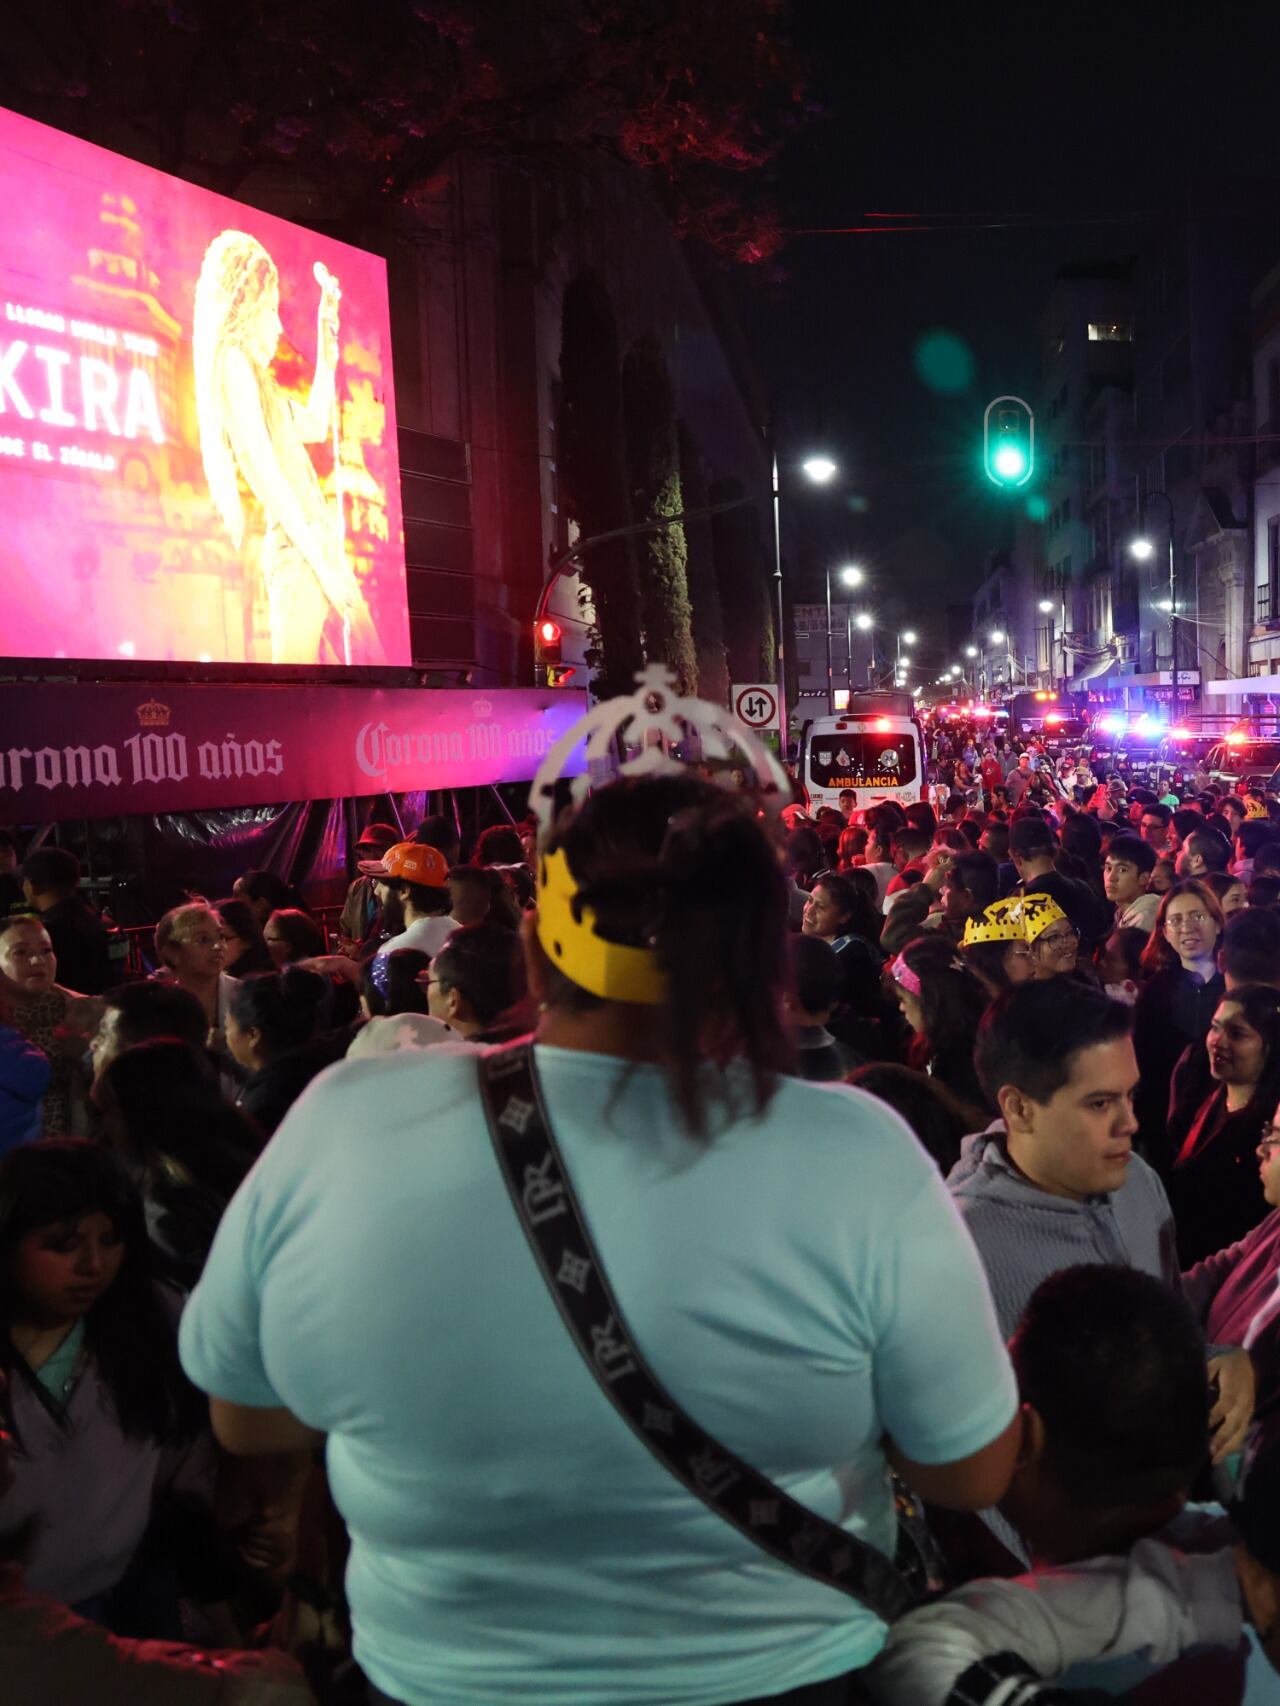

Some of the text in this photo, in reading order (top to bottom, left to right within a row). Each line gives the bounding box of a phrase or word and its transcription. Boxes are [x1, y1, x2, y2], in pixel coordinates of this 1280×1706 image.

[0, 340, 165, 444] KIRA
[0, 732, 284, 792] rona 100 años
[356, 721, 464, 778] Corona
[467, 723, 501, 761] 100
[828, 776, 899, 788] AMBULANCIA
